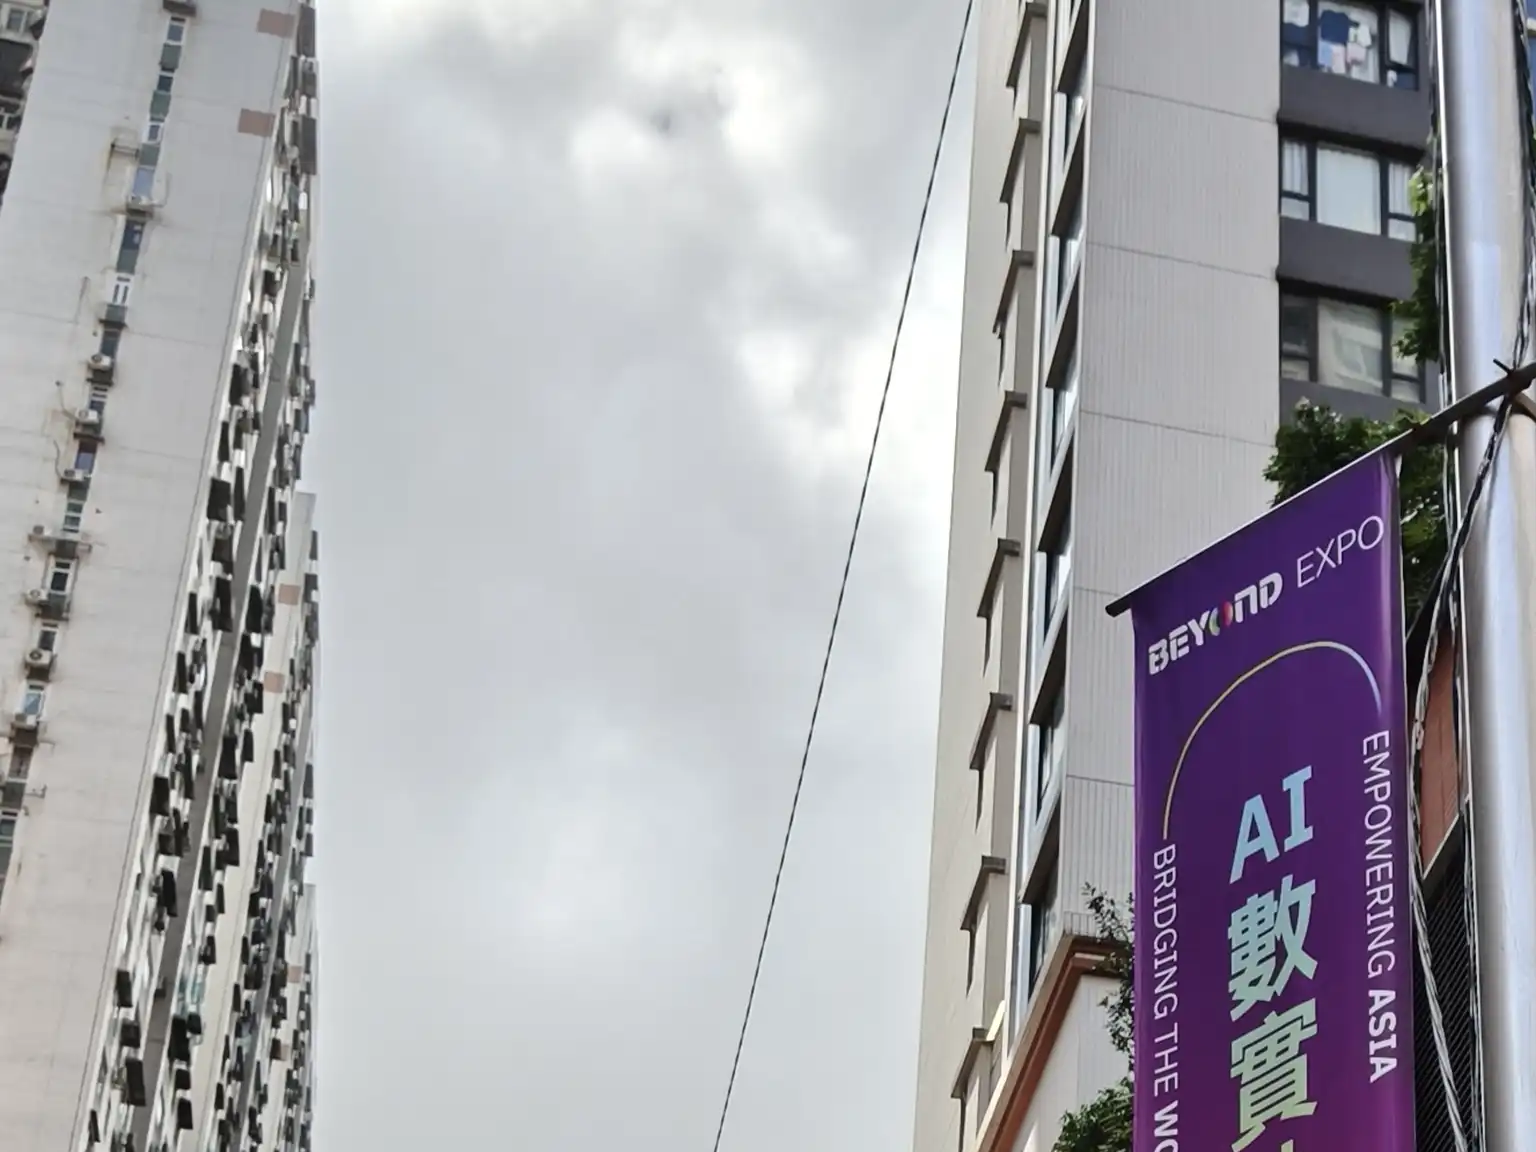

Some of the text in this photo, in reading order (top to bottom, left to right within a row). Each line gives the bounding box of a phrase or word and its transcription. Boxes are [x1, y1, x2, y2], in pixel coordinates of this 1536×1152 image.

[1148, 515, 1384, 675] BEYOND EXPO
[1153, 844, 1179, 1020] BRIDGING
[1363, 730, 1398, 1083] EMPOWERING ASIA
[1154, 1023, 1179, 1097] THE
